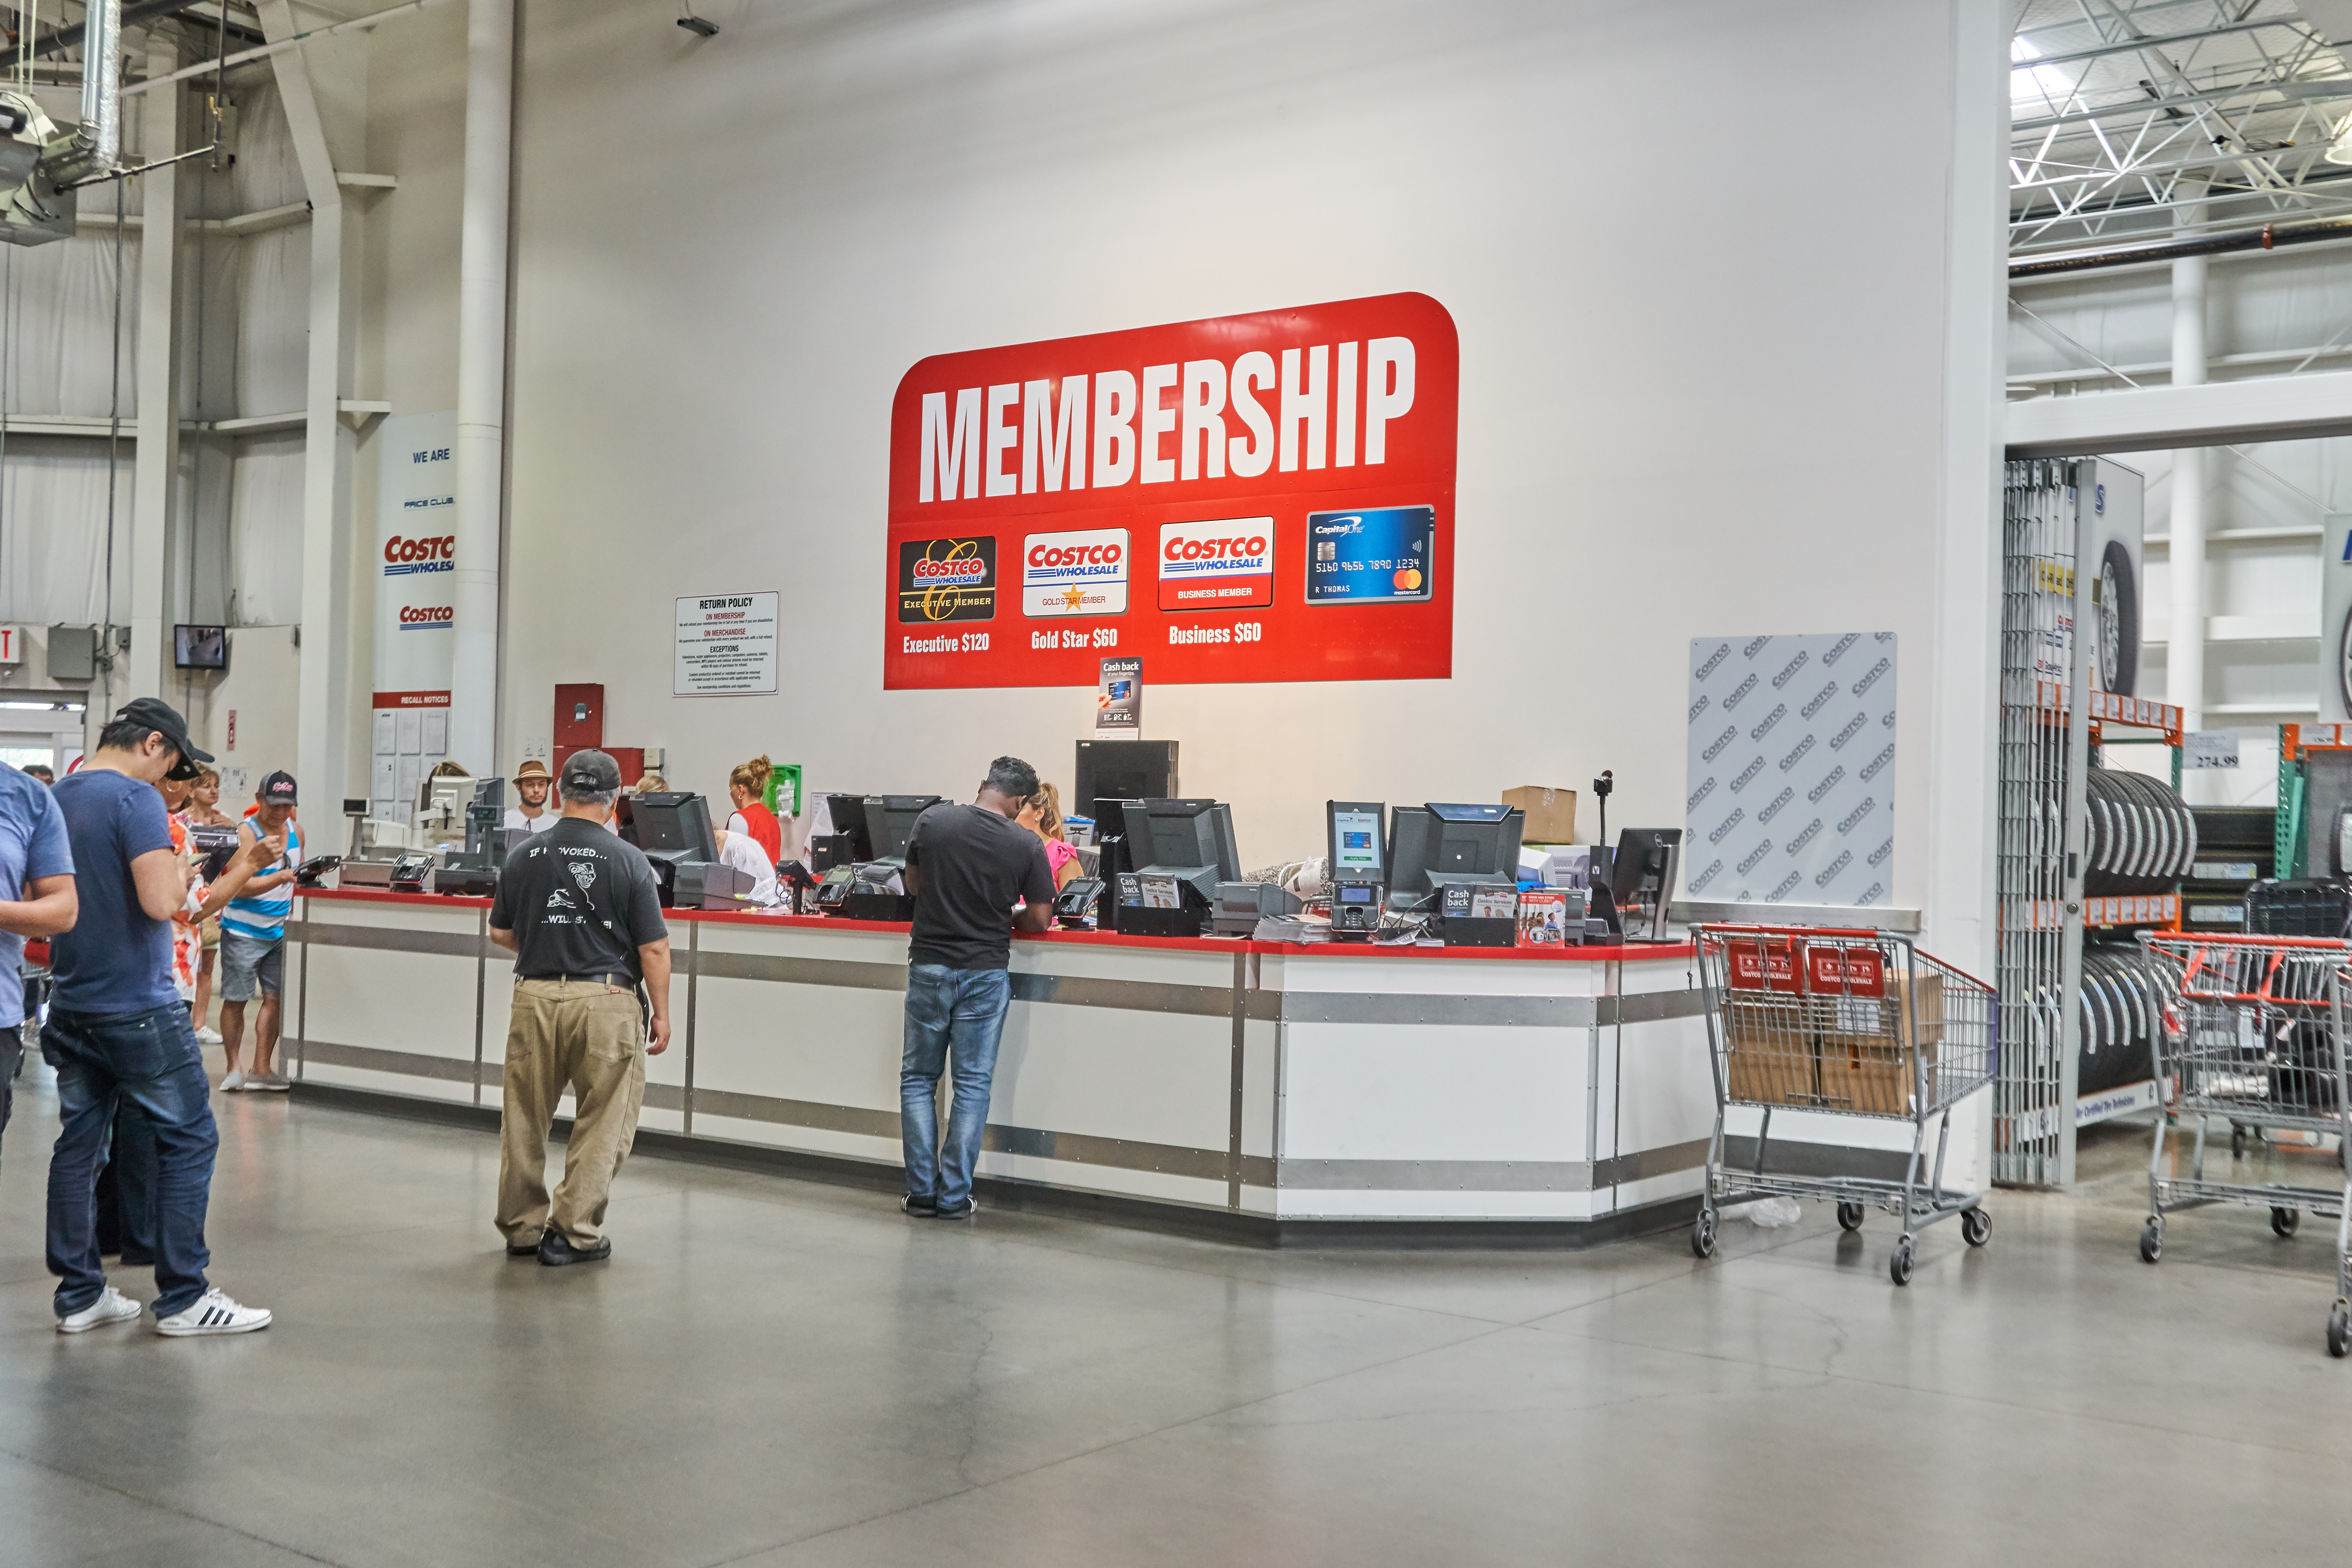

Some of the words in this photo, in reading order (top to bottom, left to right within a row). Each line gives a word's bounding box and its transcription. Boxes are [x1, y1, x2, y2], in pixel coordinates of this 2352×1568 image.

[919, 336, 1415, 503] MEMBERSHIP
[413, 451, 428, 463] WE
[430, 448, 450, 461] ARE
[404, 500, 428, 508] PRICE
[430, 497, 453, 506] CLUB
[385, 535, 455, 563] COSTC
[1028, 544, 1122, 568] COSTCO
[1164, 536, 1266, 561] COSTCO
[915, 559, 983, 577] COSTCO
[1056, 565, 1119, 577] WHOLESALE
[1195, 558, 1263, 571] WHOLESALE
[1316, 562, 1338, 573] 5160
[1342, 561, 1364, 571] 9656
[1368, 560, 1391, 570] 7890
[1396, 558, 1419, 569] 1234
[935, 575, 980, 584] WHOLESALE
[700, 599, 726, 609] RETURN
[728, 597, 753, 608] POLICY
[904, 599, 951, 608] EXECUTIVE
[954, 598, 991, 606] MEMBER
[1178, 590, 1216, 599] BUSINESS
[1218, 588, 1252, 597] MEMBER
[400, 605, 453, 622] COSTCO
[713, 612, 745, 620] MEMBERSHIP
[712, 628, 746, 636] MERCHANDISE
[903, 635, 958, 653] Executive
[962, 633, 990, 652] $120
[1032, 631, 1058, 649] Gold
[1062, 629, 1089, 647] Star
[1093, 628, 1117, 648] $60
[1169, 625, 1230, 644] Business
[1234, 622, 1261, 644] $60
[1103, 662, 1120, 671] Cash
[1122, 662, 1139, 670] back
[1696, 643, 1728, 679] COSTCO
[1710, 649, 1732, 672] WHOLESALE
[1772, 651, 1807, 687] COSTCO
[1786, 656, 1809, 680] WHOLESALE
[1852, 657, 1888, 694] COSTCO
[1868, 663, 1891, 687] WHOLESALE
[1723, 673, 1757, 709] COSTCO
[1738, 678, 1760, 701] WHOLESALE
[1801, 681, 1836, 717] COSTCO
[1816, 686, 1839, 710] WHOLESALE
[1751, 703, 1785, 739] COSTCO
[1765, 709, 1788, 733] WHOLESALE
[1830, 712, 1865, 748] COSTCO
[1845, 718, 1869, 741] WHOLESALE
[1702, 726, 1735, 760] COSTCO
[1717, 731, 1739, 754] WHOLESALE
[1779, 734, 1814, 770] COSTCO
[1793, 740, 1817, 764] WHOLESALE
[1730, 756, 1764, 791] COSTCO
[1744, 761, 1767, 784] WHOLESALE
[1860, 743, 1895, 780] COSTCO
[1808, 765, 1842, 801] COSTCO
[1823, 771, 1846, 795] WHOLESALE
[1758, 787, 1792, 822] COSTCO
[1773, 792, 1795, 816] WHOLESALE
[1838, 797, 1872, 833] COSTCO
[1852, 802, 1876, 826] WHOLESALE
[1709, 808, 1742, 842] COSTCO
[1723, 813, 1745, 836] WHOLESALE
[1786, 818, 1821, 854] COSTCO
[1801, 824, 1824, 848] WHOLESALE
[530, 848, 540, 857] IF
[1737, 838, 1771, 873] COSTCO
[1751, 844, 1774, 868] WHOLESALE
[1688, 859, 1721, 893] COSTCO
[1702, 864, 1724, 888] WHOLESALE
[1815, 850, 1851, 885] COSTCO
[1831, 856, 1854, 879] WHOLESALE
[1448, 890, 1469, 898] Cash
[1765, 871, 1799, 903] COSTCO
[1779, 876, 1802, 901] WHOLESALE
